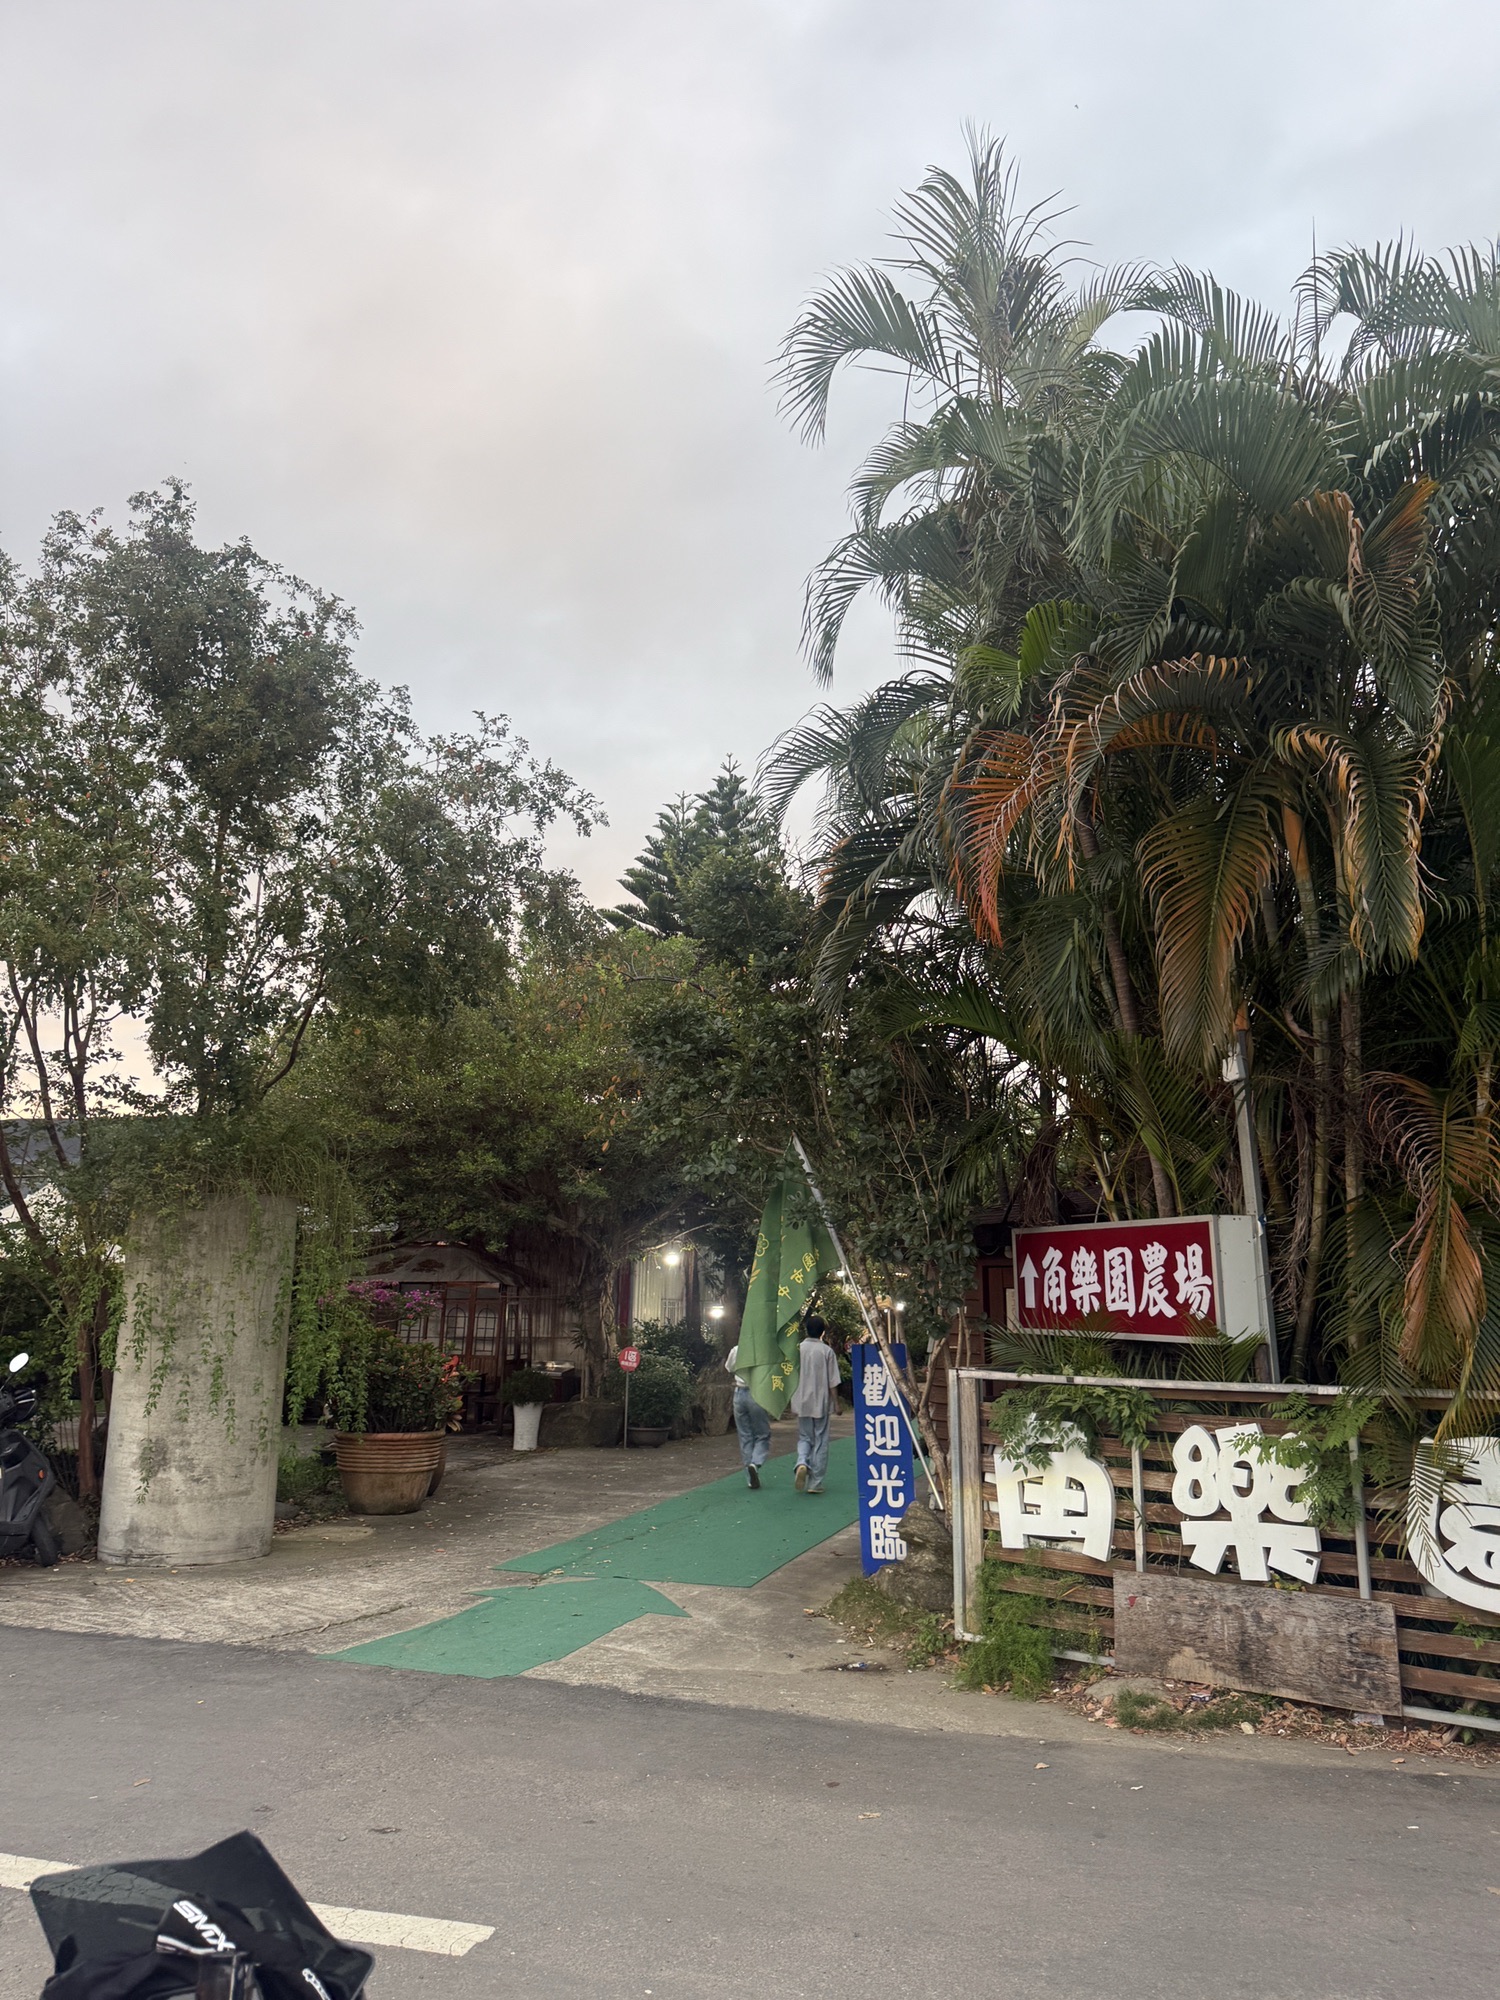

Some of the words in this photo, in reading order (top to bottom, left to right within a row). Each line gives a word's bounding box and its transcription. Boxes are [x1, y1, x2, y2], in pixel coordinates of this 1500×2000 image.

[1041, 1241, 1213, 1320] 角樂園農場
[862, 1363, 907, 1560] 歡迎光臨
